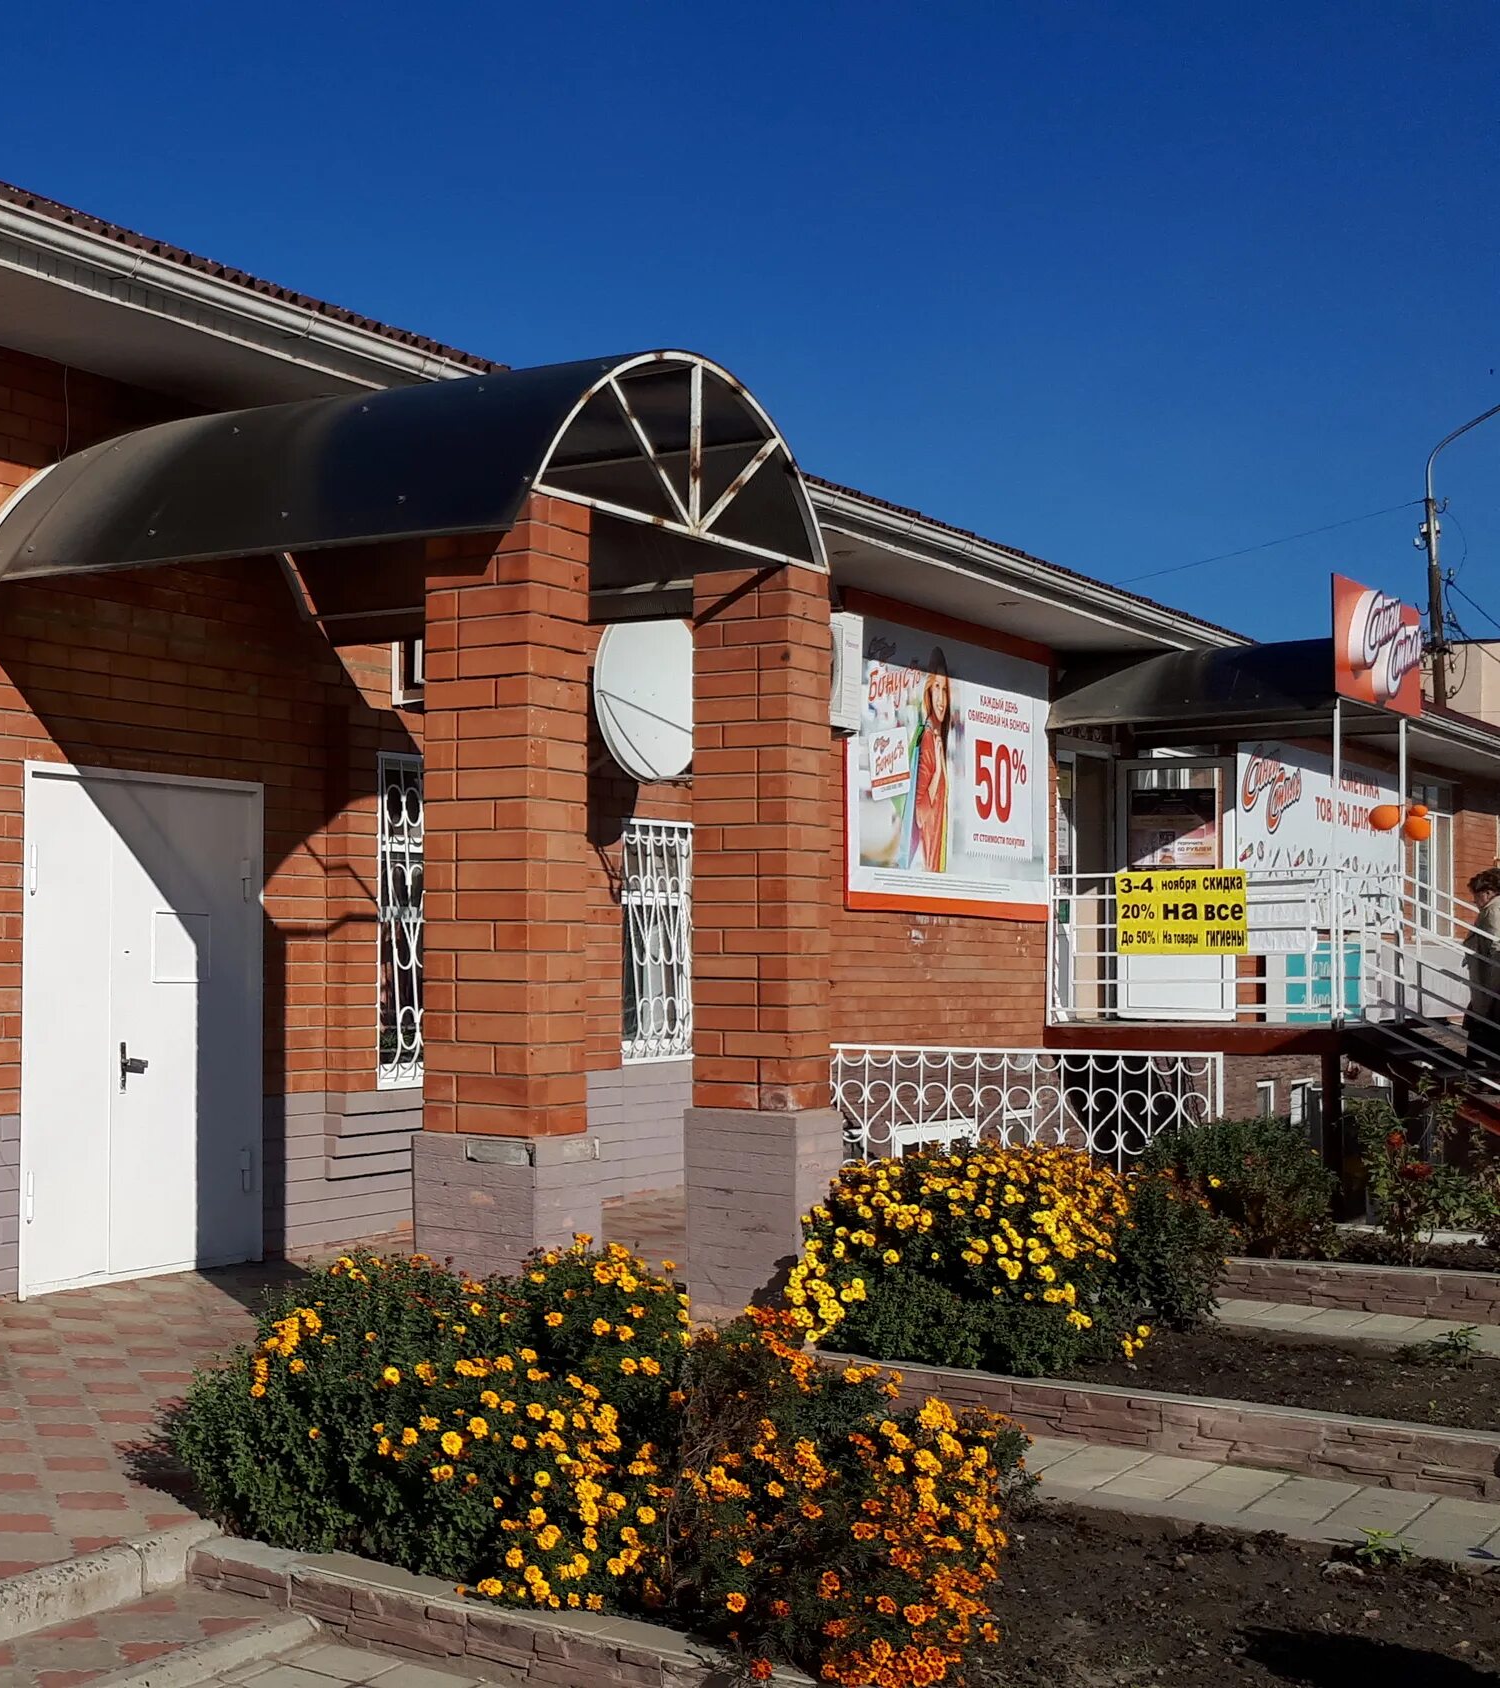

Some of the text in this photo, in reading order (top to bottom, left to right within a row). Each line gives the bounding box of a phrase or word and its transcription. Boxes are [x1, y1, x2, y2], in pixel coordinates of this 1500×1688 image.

[980, 694, 1018, 715] КАЖДЫЙ ДЕНЬ
[967, 709, 1030, 734] ОБМЕНИВАЙ НА БОНУСЫ
[975, 738, 1027, 823] 50%
[1330, 768, 1380, 800] СМЕТИКА
[1315, 796, 1350, 827] ТОВРЫ
[1351, 804, 1369, 834] ДЛЯ
[973, 833, 1025, 849] ОТ СТОИМОСТИ ПОКУПКИ
[1120, 877, 1154, 893] 3-4
[1161, 876, 1197, 893] ноября
[1121, 903, 1243, 921] 20% на все
[1121, 931, 1134, 946] До
[1136, 931, 1156, 944] 50%
[1163, 930, 1172, 943] На
[1173, 933, 1198, 947] товары
